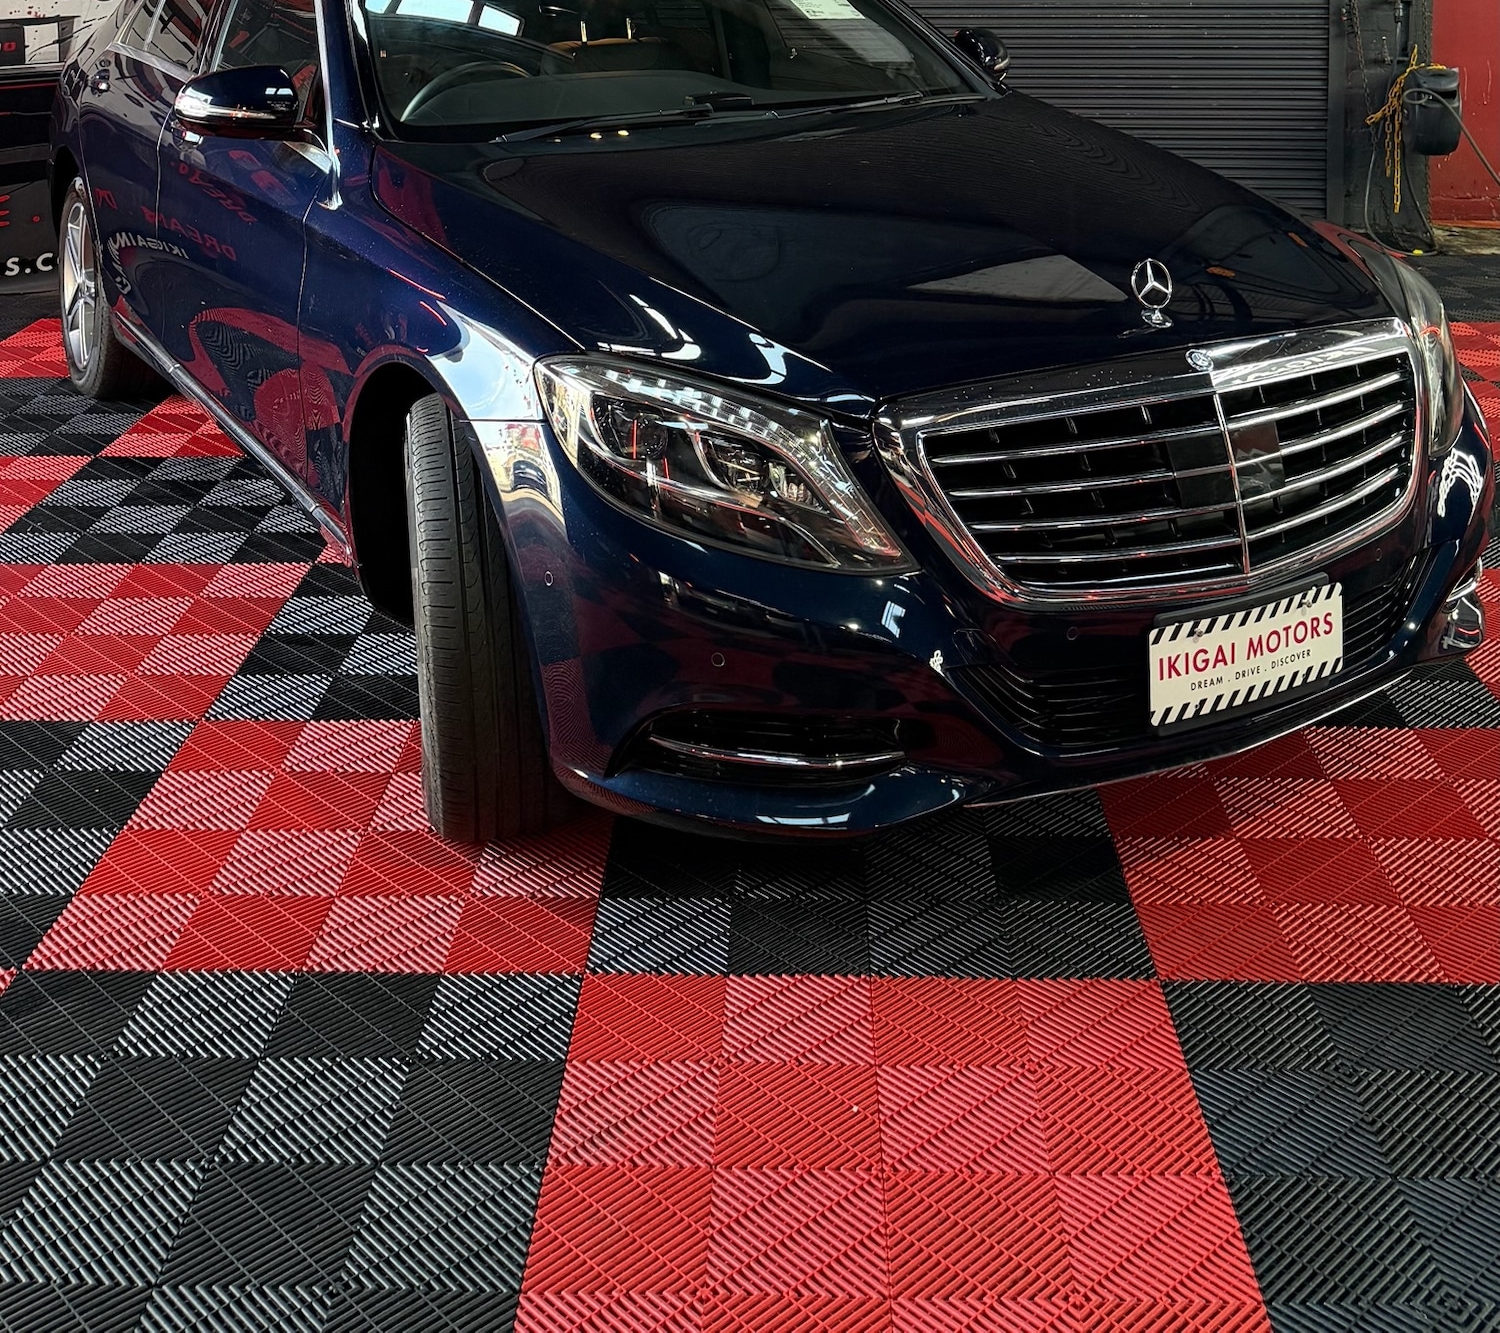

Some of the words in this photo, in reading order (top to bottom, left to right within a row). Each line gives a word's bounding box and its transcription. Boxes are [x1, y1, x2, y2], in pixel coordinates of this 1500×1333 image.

[4, 252, 60, 277] S.C
[1158, 642, 1236, 681] IKIGAI
[1246, 612, 1334, 661] MOTORS
[1190, 676, 1224, 691] DREAM
[1235, 666, 1261, 680] DRIVE
[1270, 649, 1312, 670] DISCOVER
